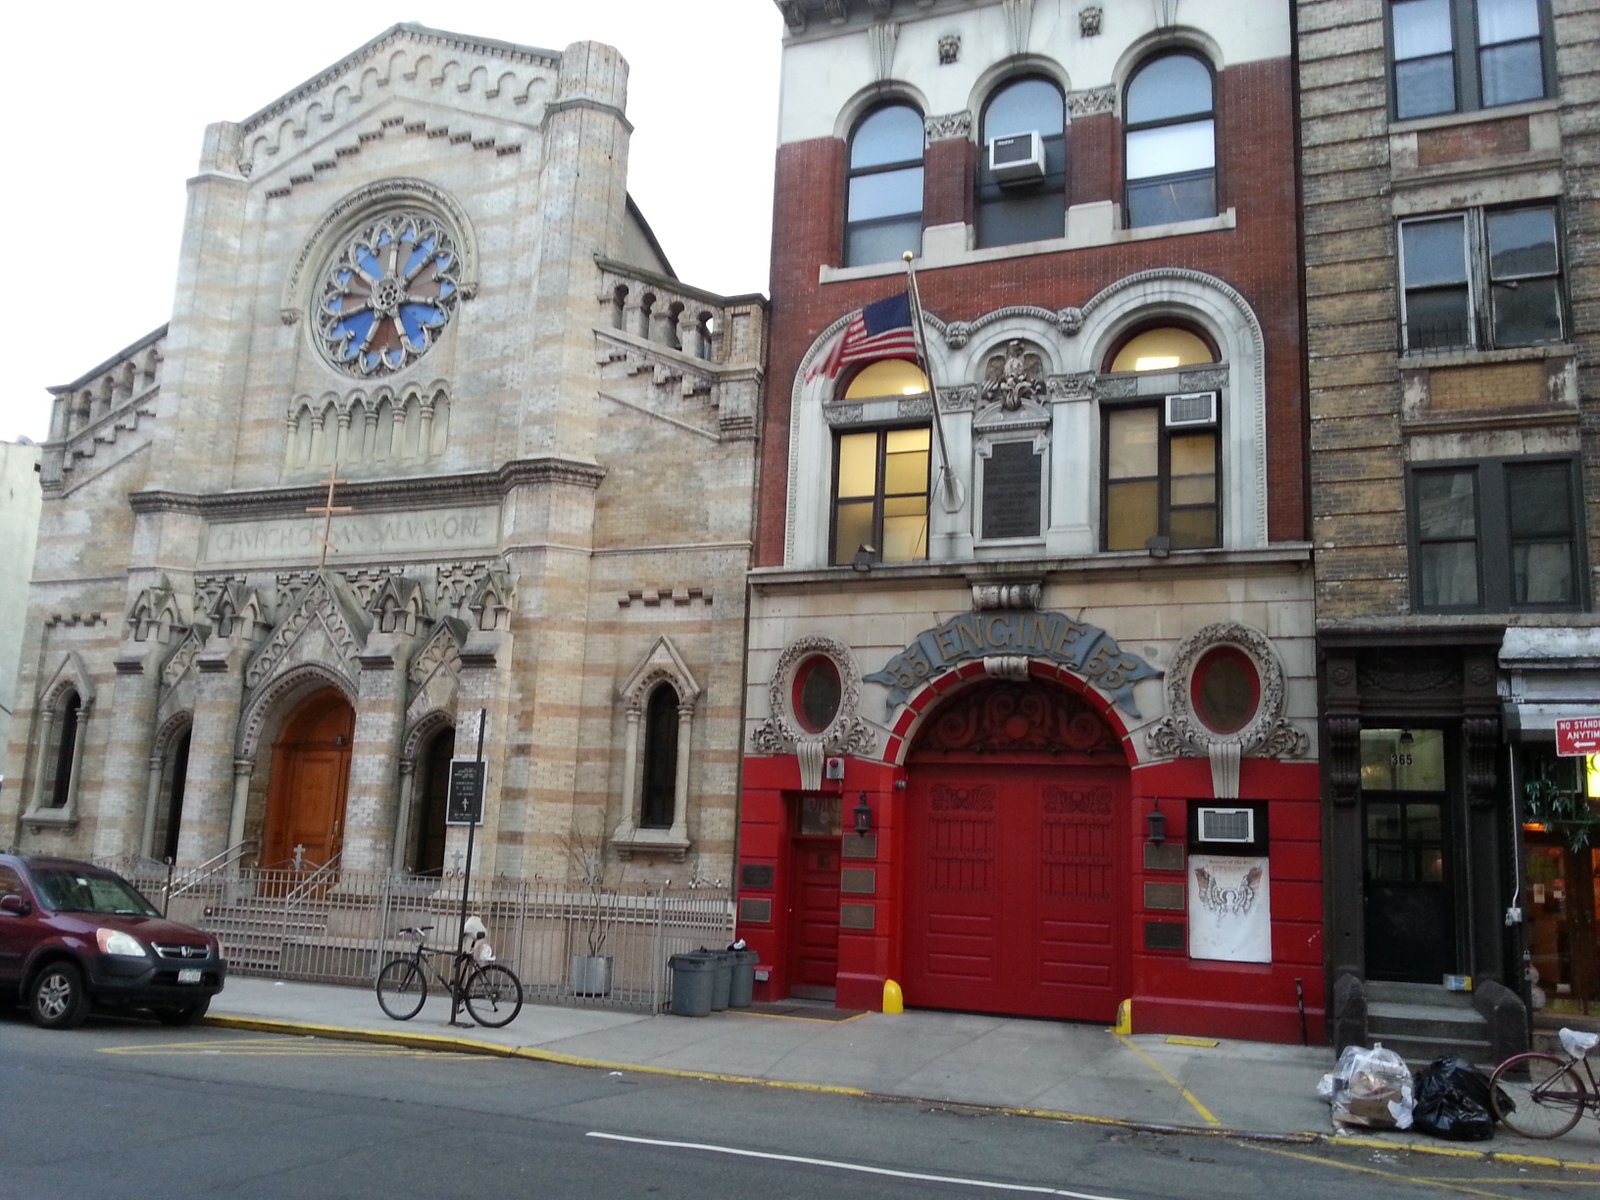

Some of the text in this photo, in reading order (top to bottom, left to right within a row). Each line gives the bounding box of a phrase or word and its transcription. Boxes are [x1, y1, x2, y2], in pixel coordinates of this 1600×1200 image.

[371, 515, 482, 545] SALVATORE
[887, 615, 1136, 689] 55 ENGINE 55
[1560, 721, 1571, 730] NO
[1391, 754, 1413, 766] 365
